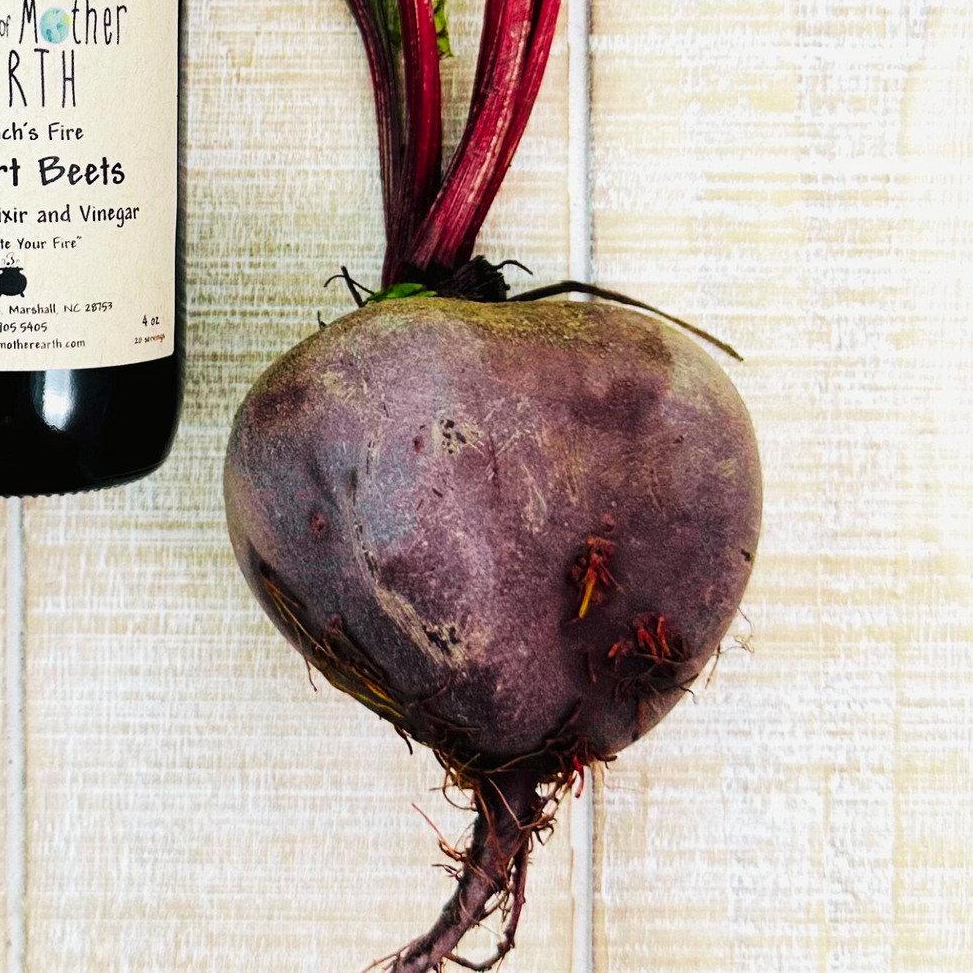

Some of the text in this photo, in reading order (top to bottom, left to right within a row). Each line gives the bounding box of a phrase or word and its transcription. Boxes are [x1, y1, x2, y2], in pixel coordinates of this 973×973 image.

[47, 121, 85, 141] Fire
[37, 155, 126, 187] Beets
[36, 203, 72, 224] and
[78, 204, 140, 229] Vinegar
[16, 237, 48, 250] Your
[63, 302, 81, 313] NC
[84, 301, 113, 313] 28753
[141, 314, 160, 327] 4 oz
[19, 321, 48, 334] 5405
